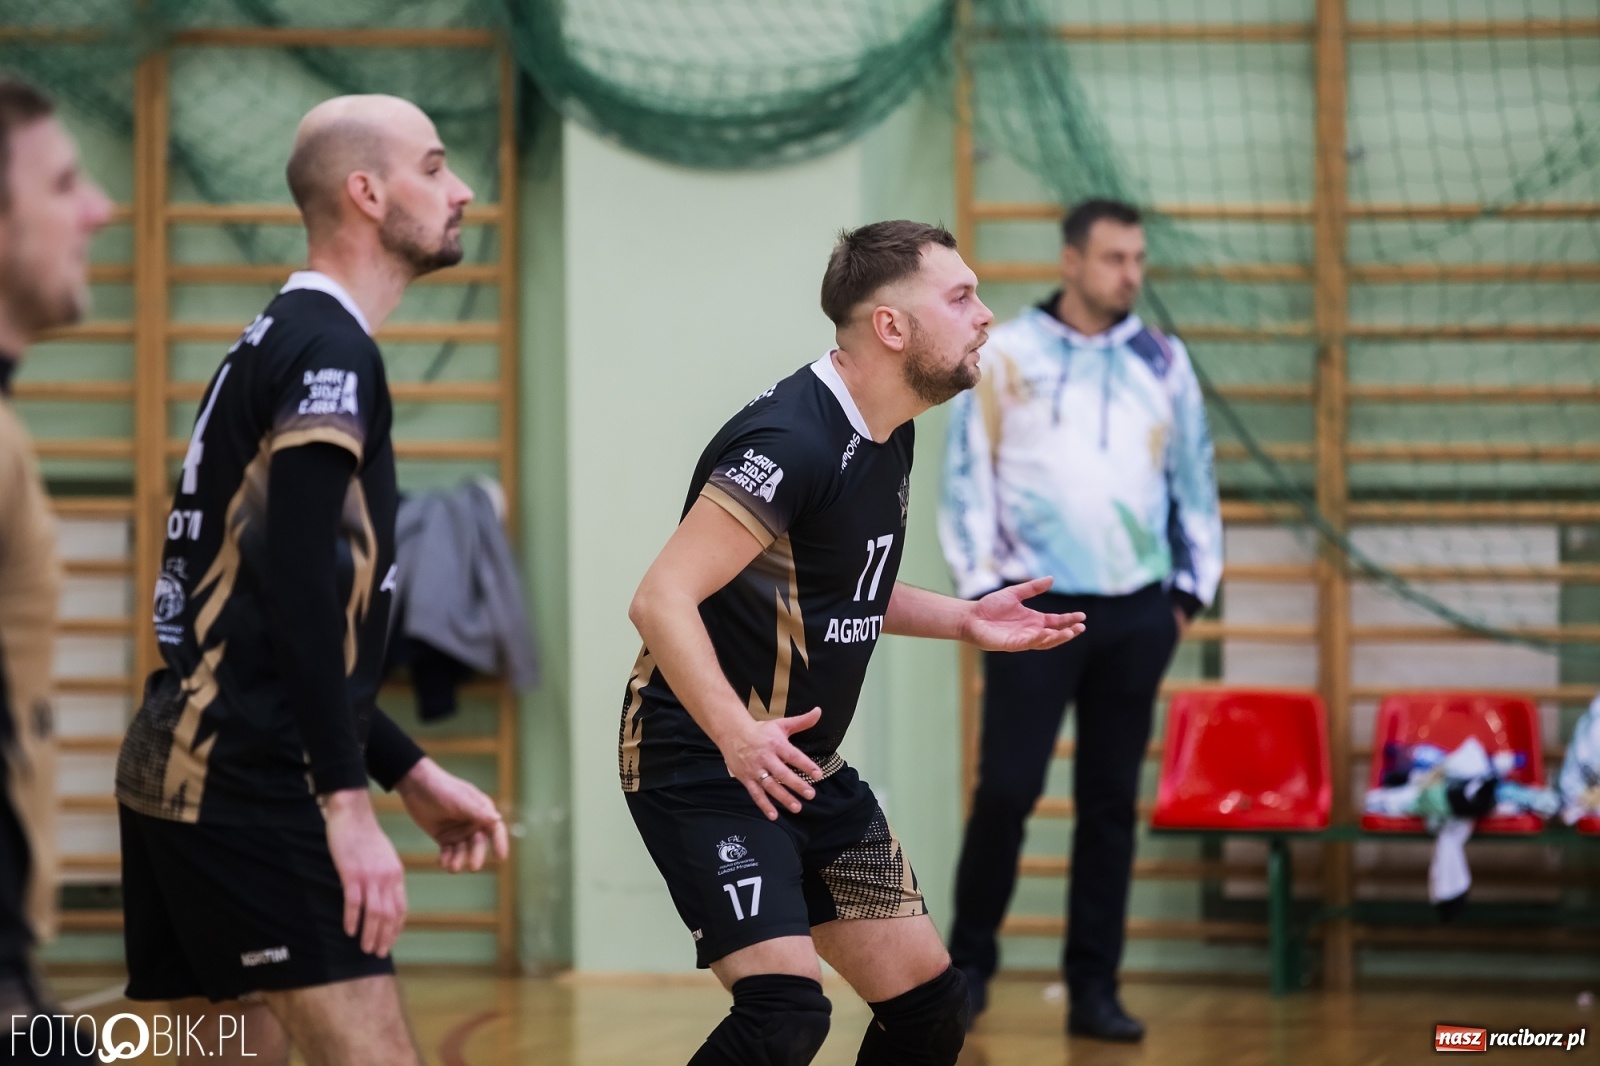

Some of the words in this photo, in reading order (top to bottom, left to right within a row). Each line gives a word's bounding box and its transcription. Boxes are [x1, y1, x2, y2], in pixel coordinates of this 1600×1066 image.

[740, 461, 768, 484] SIDE
[743, 448, 778, 474] DARK
[725, 467, 757, 493] CARS
[853, 534, 894, 602] 17
[723, 876, 763, 921] 17
